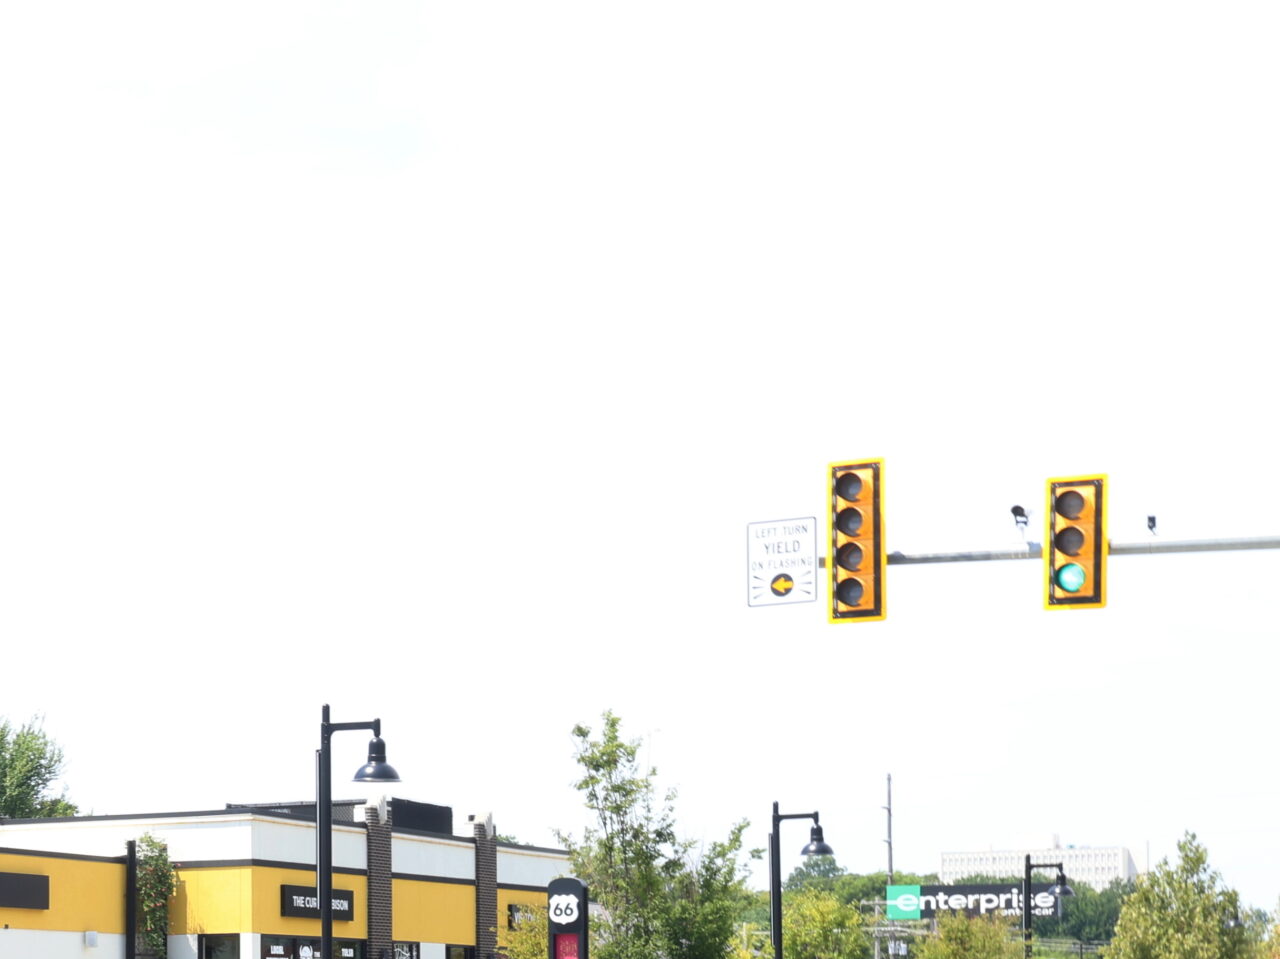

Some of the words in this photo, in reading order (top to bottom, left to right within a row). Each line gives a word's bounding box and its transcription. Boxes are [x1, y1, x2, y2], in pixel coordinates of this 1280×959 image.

[755, 526, 777, 539] LEFT
[783, 524, 808, 536] TURN
[763, 540, 801, 555] YIELD
[751, 560, 764, 572] ON
[767, 556, 813, 570] FLASHING
[292, 895, 305, 908] THE
[331, 898, 349, 911] BISON
[553, 902, 574, 917] 66
